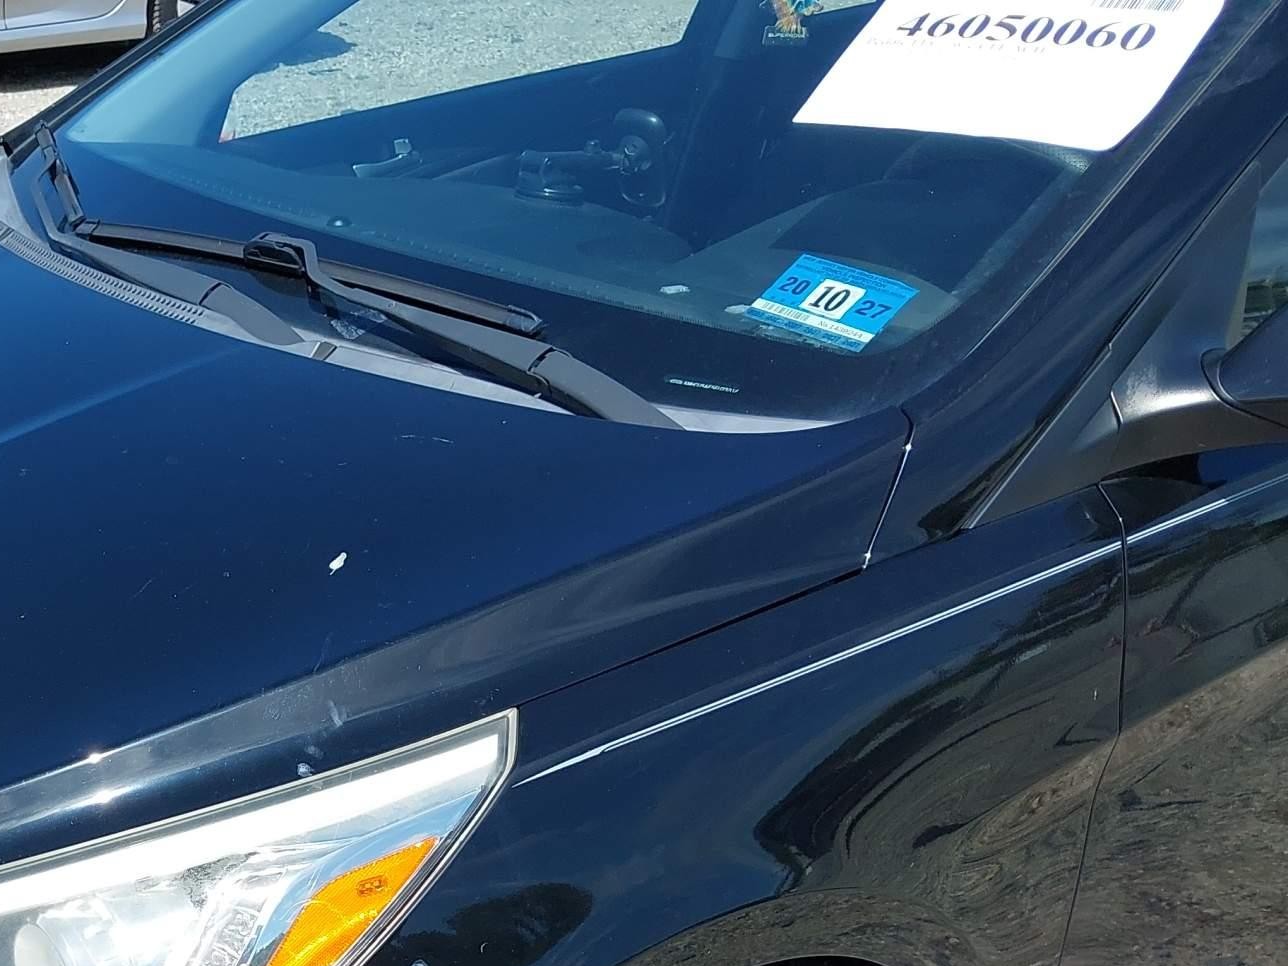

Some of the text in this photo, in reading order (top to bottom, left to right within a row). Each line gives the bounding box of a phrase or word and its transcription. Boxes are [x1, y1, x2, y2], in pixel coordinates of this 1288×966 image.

[896, 12, 1156, 51] 46050060
[778, 276, 892, 319] 20 10 27
